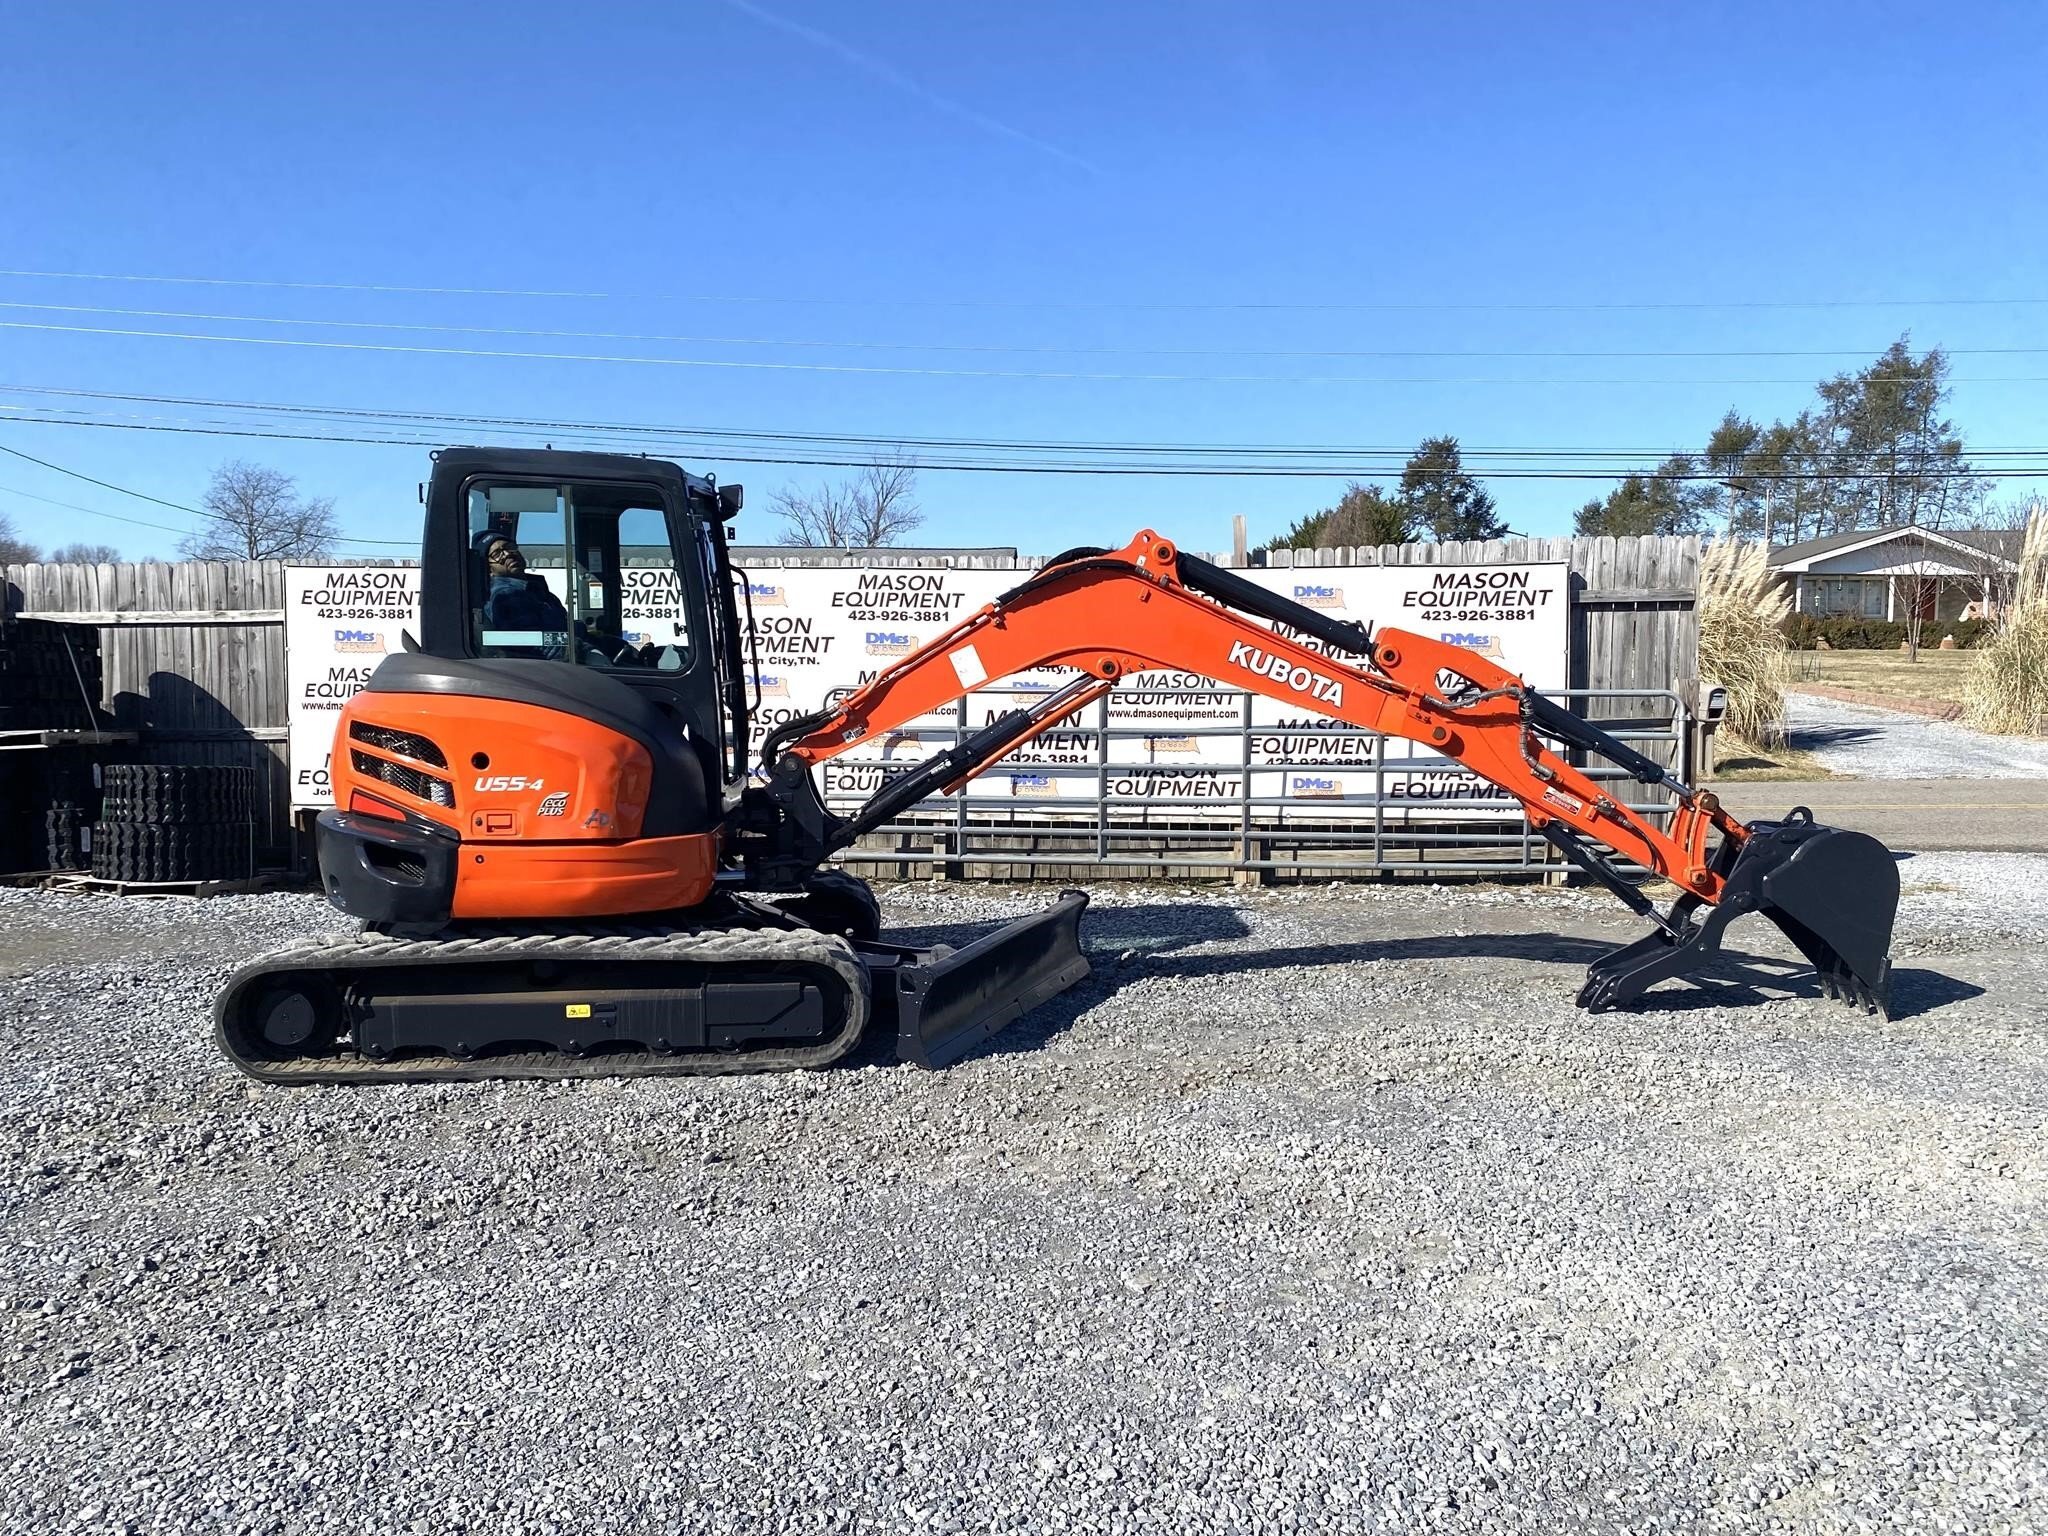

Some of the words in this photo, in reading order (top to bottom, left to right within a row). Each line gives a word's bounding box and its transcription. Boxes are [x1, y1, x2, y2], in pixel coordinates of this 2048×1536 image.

[326, 573, 406, 588] MASON
[620, 571, 674, 588] SON
[858, 574, 943, 591] MASON
[1433, 572, 1529, 589] MASON
[831, 592, 965, 608] EQUIPMENT
[1403, 589, 1553, 607] EQUIPMENT
[317, 608, 413, 619] 423-926-3881
[622, 608, 680, 619] 26-3881
[848, 610, 949, 621] 423-926-3881
[1421, 610, 1535, 621] 423-926-3881
[738, 617, 812, 634] ASON
[740, 636, 835, 653] IPMENT
[769, 656, 820, 667] City,TN.
[328, 667, 371, 682] MAS
[1136, 673, 1216, 689] MASON
[1228, 640, 1344, 708] KUBOTA
[304, 683, 365, 698] EQUIP
[1111, 692, 1234, 706] EQUIPMENT
[749, 708, 809, 725] SON
[1107, 708, 1239, 720] www.dmasonequipment.com
[1277, 719, 1364, 730] MASO
[1000, 753, 1088, 764] -926-3881
[474, 776, 545, 792] U55-4
[1106, 780, 1242, 797] EQUIPMENT
[1390, 783, 1517, 799] EQUIPME
[537, 807, 565, 816] PLUS
